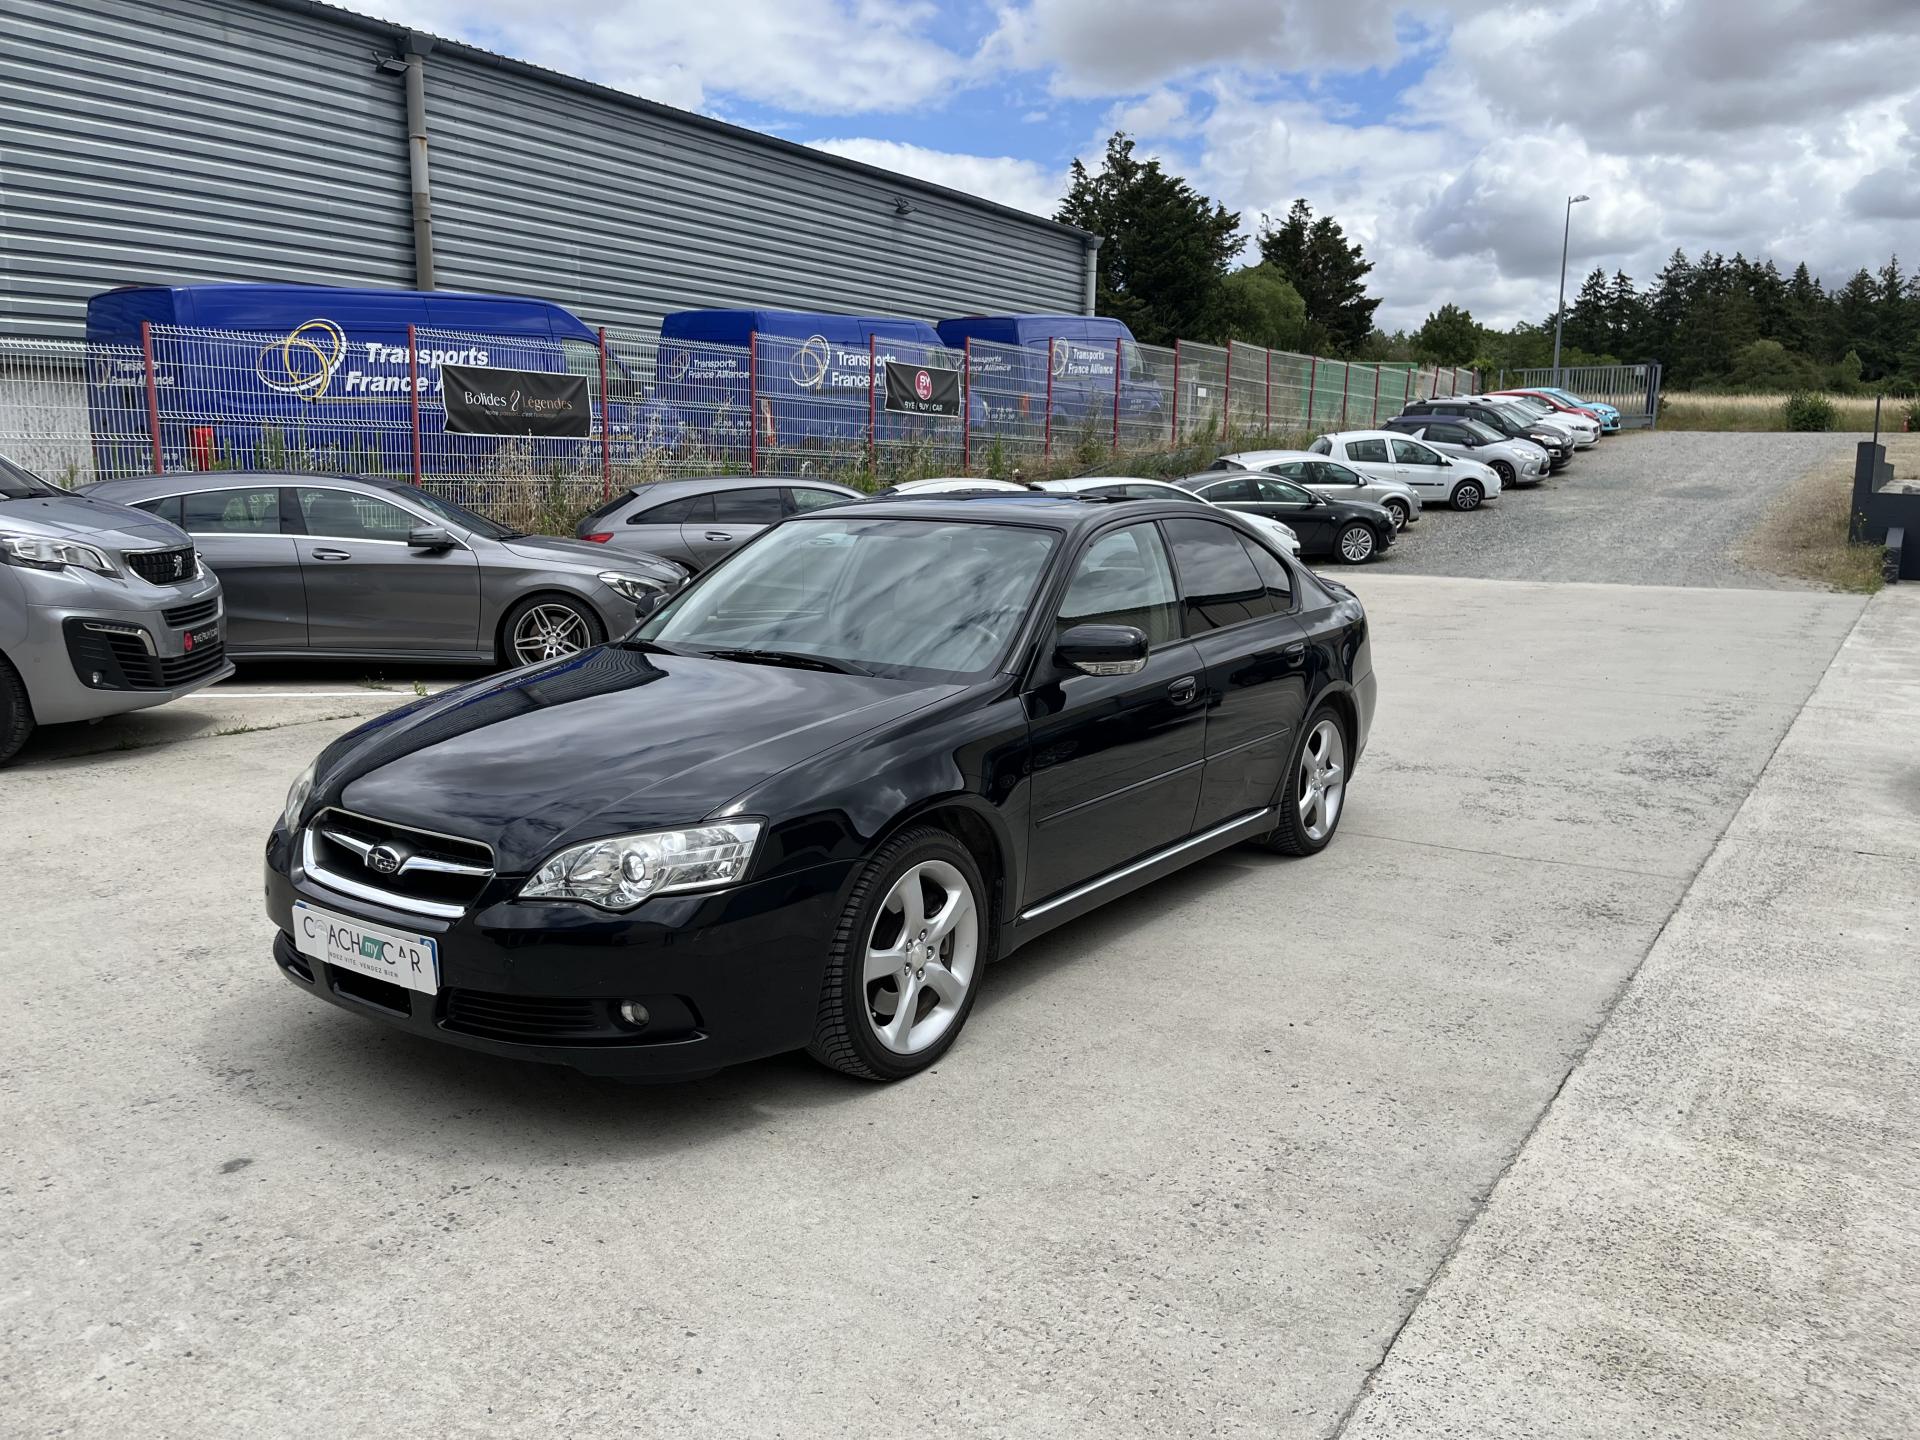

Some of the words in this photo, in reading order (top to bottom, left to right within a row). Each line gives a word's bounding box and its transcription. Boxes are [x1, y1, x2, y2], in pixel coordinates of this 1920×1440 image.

[837, 352, 896, 369] Transorts
[1073, 348, 1104, 362] Transports
[117, 361, 159, 373] Transpos
[694, 359, 736, 368] Transports
[1068, 363, 1089, 374] France
[1090, 363, 1113, 374] Alliance
[346, 371, 428, 391] France
[689, 370, 714, 378] France
[716, 370, 750, 378] Alliance
[832, 372, 870, 386] France
[464, 391, 507, 407] Bolides
[522, 395, 573, 411] Légendes
[303, 915, 362, 955] CACH
[365, 941, 379, 958] my
[381, 941, 422, 974] CAR
[359, 962, 383, 974] VENDEZ
